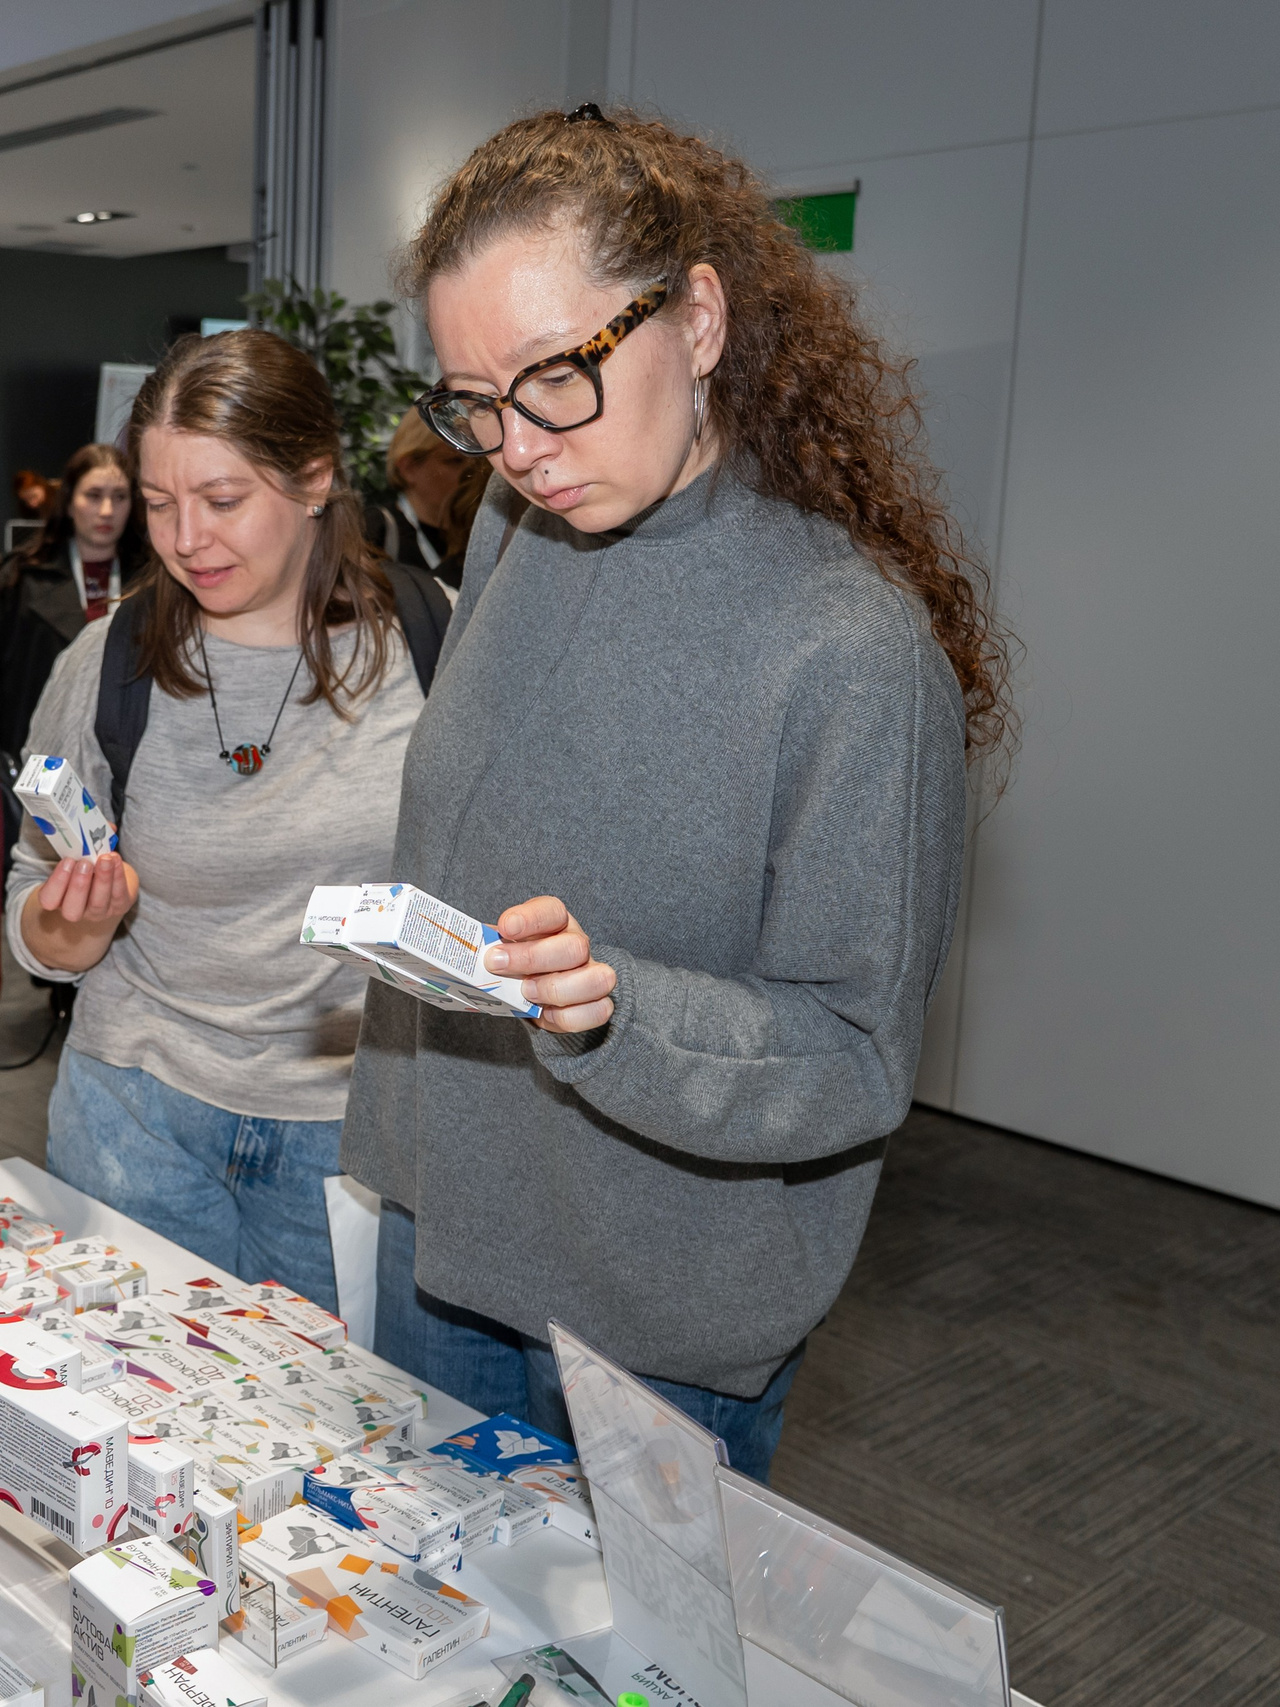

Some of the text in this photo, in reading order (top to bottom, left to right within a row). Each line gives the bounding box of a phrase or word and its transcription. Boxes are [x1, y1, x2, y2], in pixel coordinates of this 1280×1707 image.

[96, 1384, 144, 1418] ОНОКСЕ
[103, 1436, 114, 1510] МАВЕДИН 10
[416, 1602, 454, 1626] 400
[72, 1605, 119, 1660] БУТОФАН
[73, 1624, 104, 1661] АКТИВ
[631, 1671, 674, 1701] АКЦИЯ
